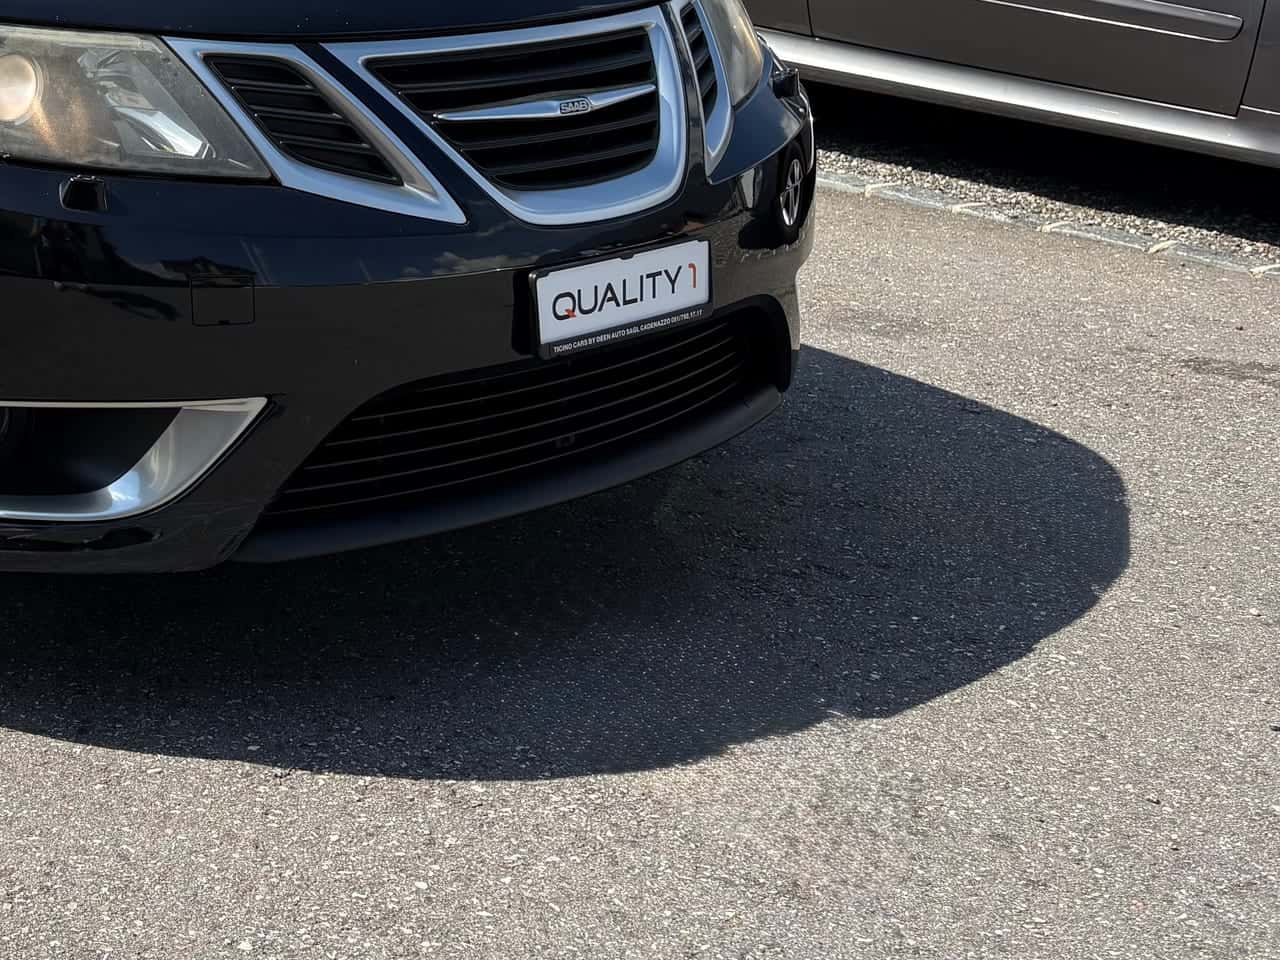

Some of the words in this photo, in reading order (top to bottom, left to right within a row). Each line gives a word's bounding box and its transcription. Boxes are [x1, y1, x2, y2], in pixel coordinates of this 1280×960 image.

[561, 100, 588, 113] SAAB
[551, 265, 683, 321] QUALITY
[573, 338, 588, 349] CARS
[611, 330, 626, 339] AUTO
